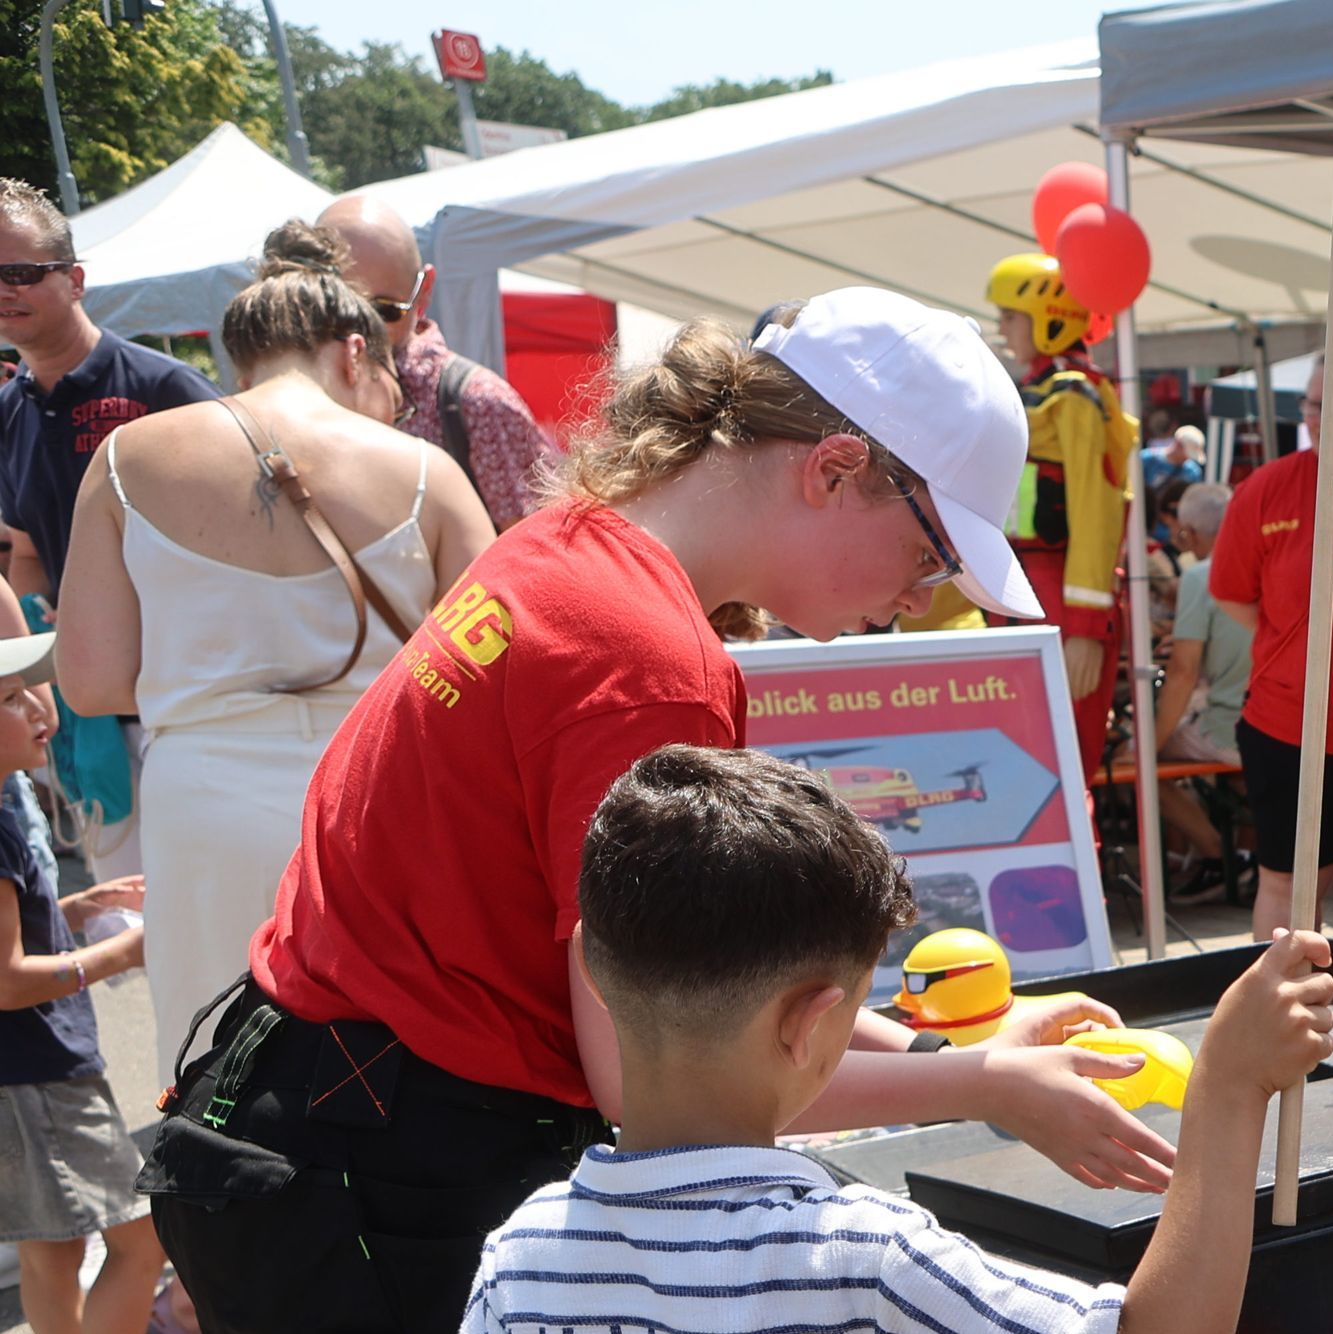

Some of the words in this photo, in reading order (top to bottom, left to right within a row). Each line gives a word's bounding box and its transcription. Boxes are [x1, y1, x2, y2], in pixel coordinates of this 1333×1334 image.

[827, 688, 882, 712] aus
[890, 682, 940, 707] der
[948, 675, 1017, 703] Luft.
